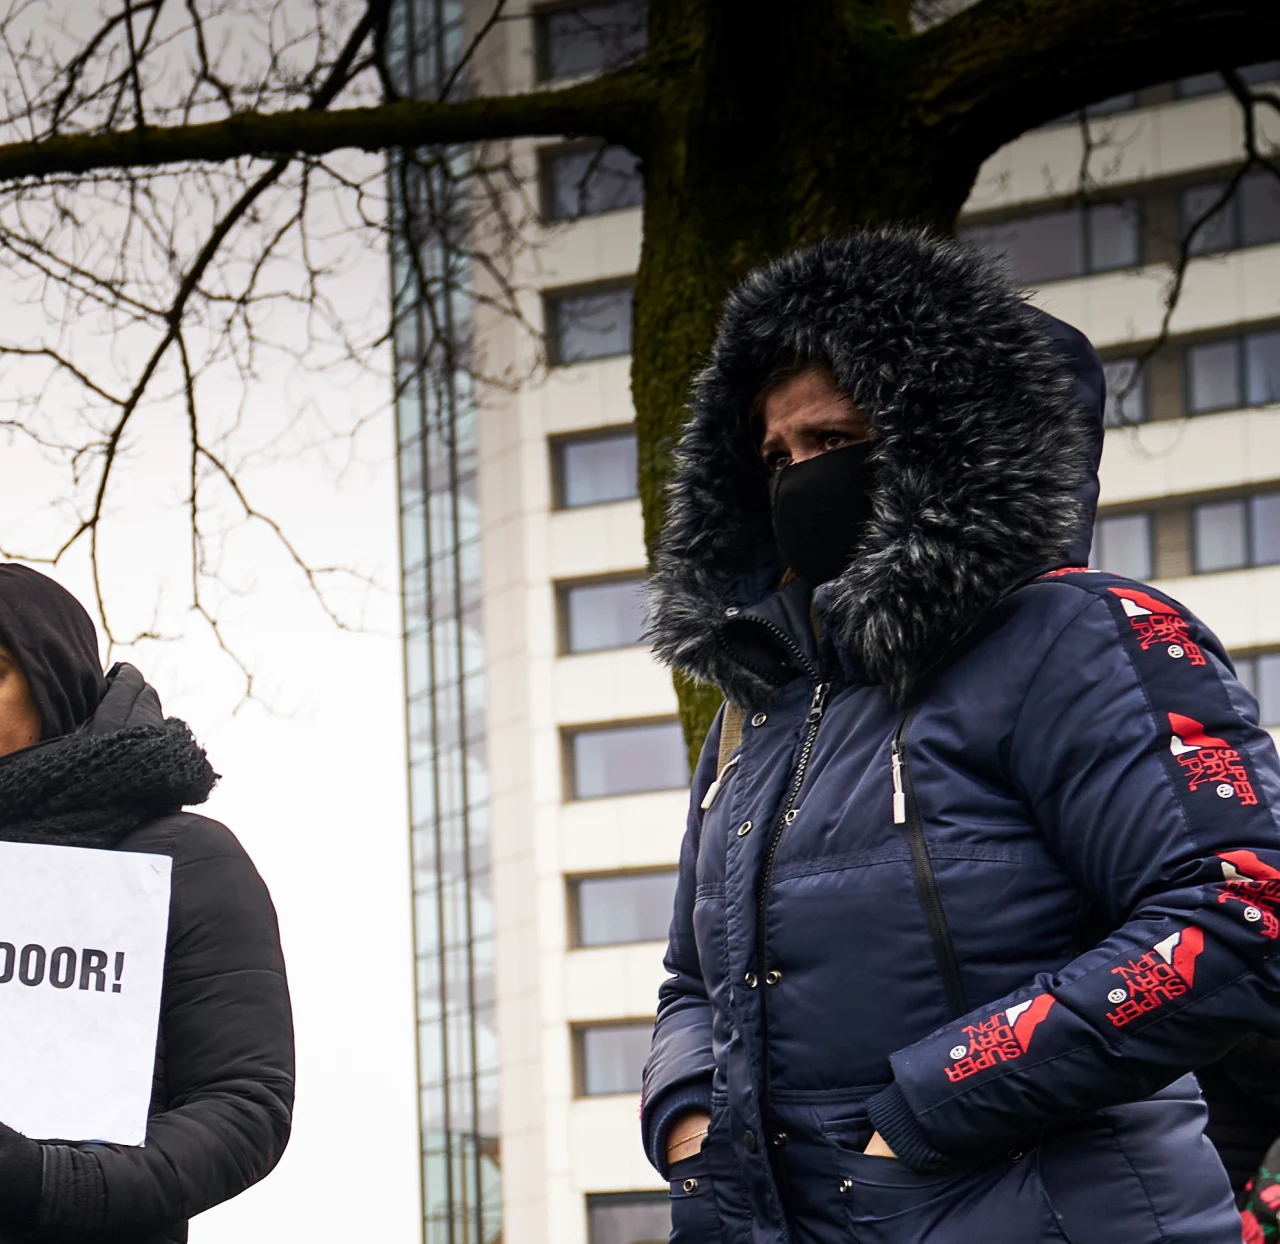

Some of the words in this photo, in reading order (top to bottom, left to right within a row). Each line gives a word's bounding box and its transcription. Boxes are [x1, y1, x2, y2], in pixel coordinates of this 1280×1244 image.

[1148, 615, 1181, 644] DRY
[1197, 748, 1232, 783] DRY
[1217, 749, 1258, 806] SUPER
[1126, 963, 1176, 998] DRY
[1105, 978, 1187, 1027] SUPER
[968, 1024, 1014, 1056] DRY
[944, 1041, 1021, 1083] SUPER
